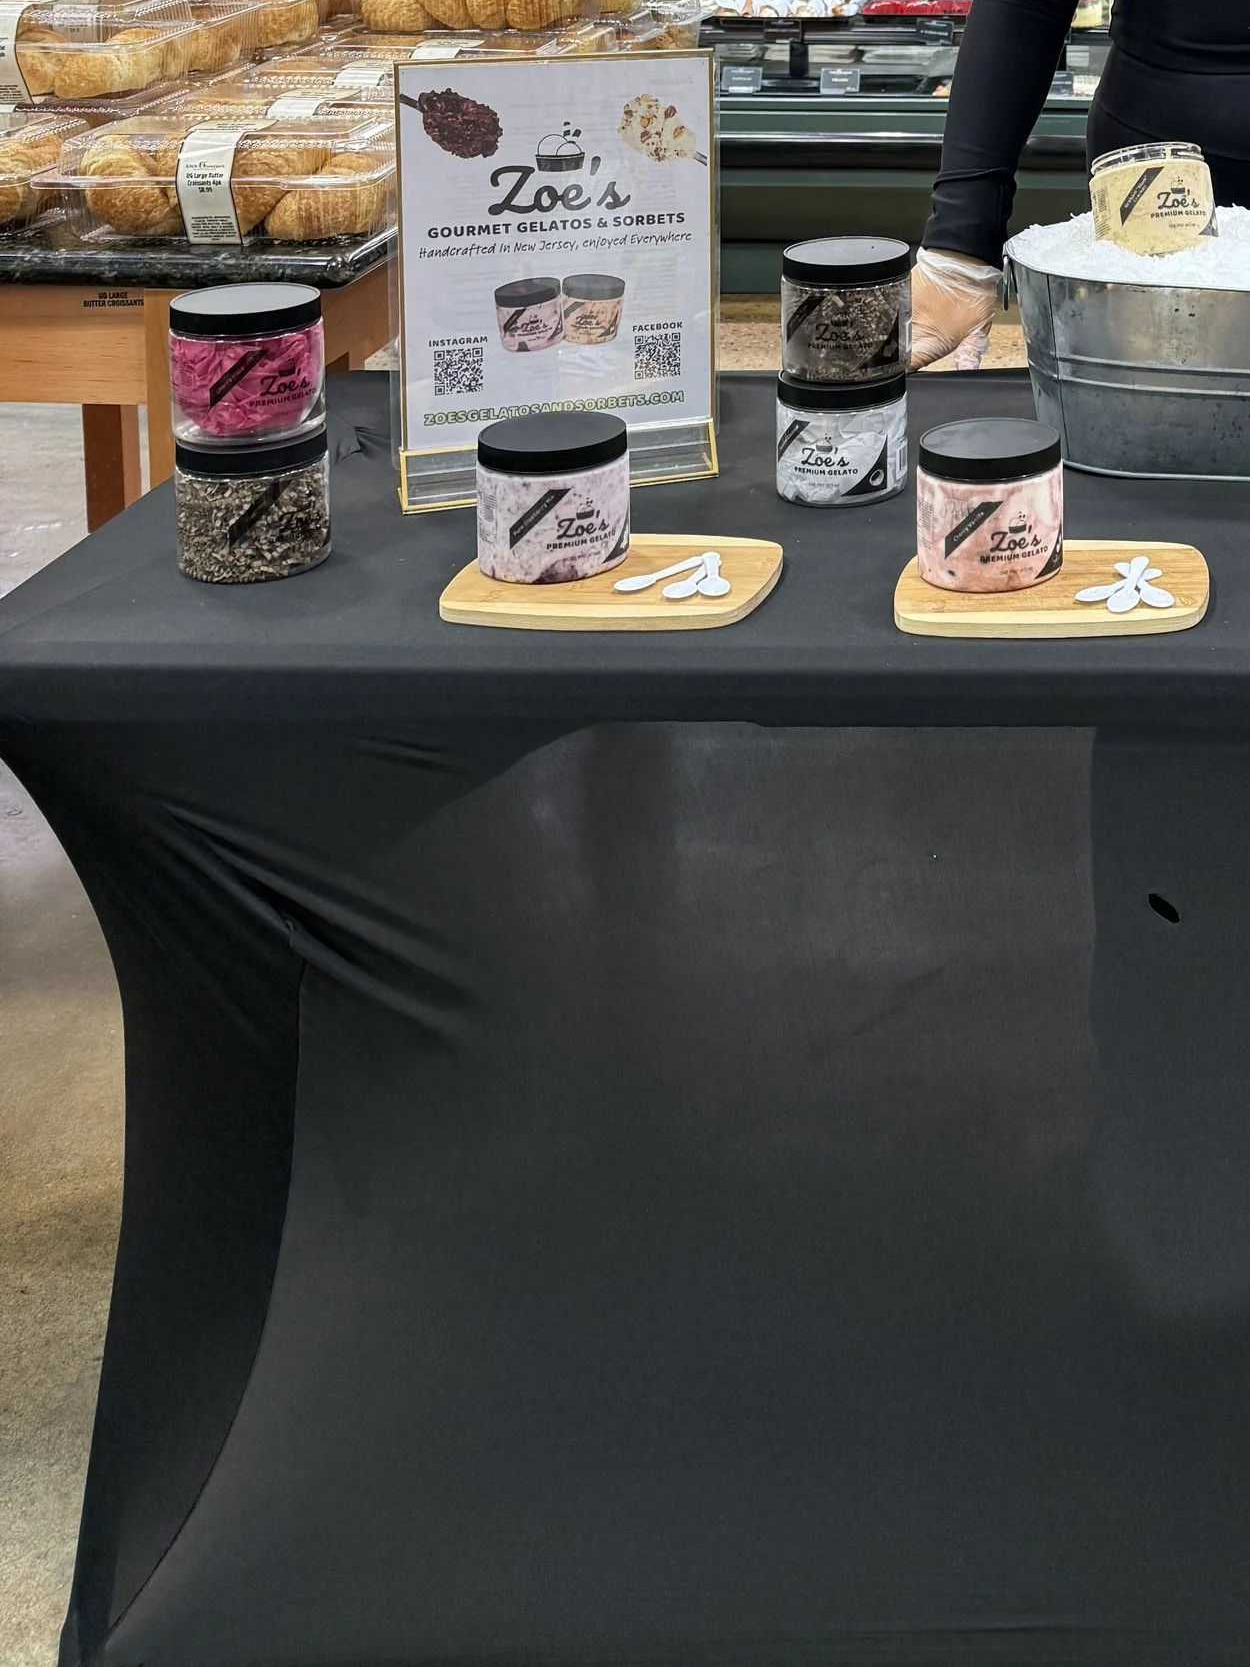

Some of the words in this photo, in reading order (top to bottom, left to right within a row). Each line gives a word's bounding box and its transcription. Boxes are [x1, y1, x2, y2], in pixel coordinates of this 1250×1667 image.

[487, 155, 631, 216] Zoe's
[1157, 188, 1200, 210] Zoe's
[1150, 210, 1184, 219] PREMIUM
[427, 222, 512, 239] GOURMET
[516, 218, 592, 234] GELATOS
[597, 217, 609, 229] &
[612, 212, 686, 227] SORBETS
[419, 243, 497, 259] Handcrafted
[513, 241, 537, 254] New
[538, 239, 581, 253] Jersey,
[582, 234, 628, 249] enjoyed
[629, 230, 693, 246] Everywhere
[83, 299, 106, 308] BUTTER
[107, 298, 144, 307] CROISSANTS
[108, 291, 128, 299] LARGE
[632, 321, 683, 333] FACEBOOK
[815, 321, 865, 342] Zoe's
[428, 336, 489, 348] INSTAGRAM
[807, 342, 841, 350] PREMIUM
[842, 341, 874, 350] GELATO
[260, 367, 311, 397] Zoe's
[248, 394, 290, 408] PREMIUM
[290, 387, 318, 402] GELATO
[424, 390, 685, 427] ZOESGELATOSANDSORBETS.COM
[801, 446, 851, 467] Zoe's
[794, 466, 826, 476] PREMIUM
[827, 467, 859, 476] GELATO
[556, 508, 610, 540] Zoe's
[546, 537, 588, 551] PREMIUM
[589, 529, 617, 545] GELATO
[989, 524, 1042, 553] Zoe's
[979, 552, 1020, 564] PREMIUM
[1021, 545, 1049, 558] GELATO
